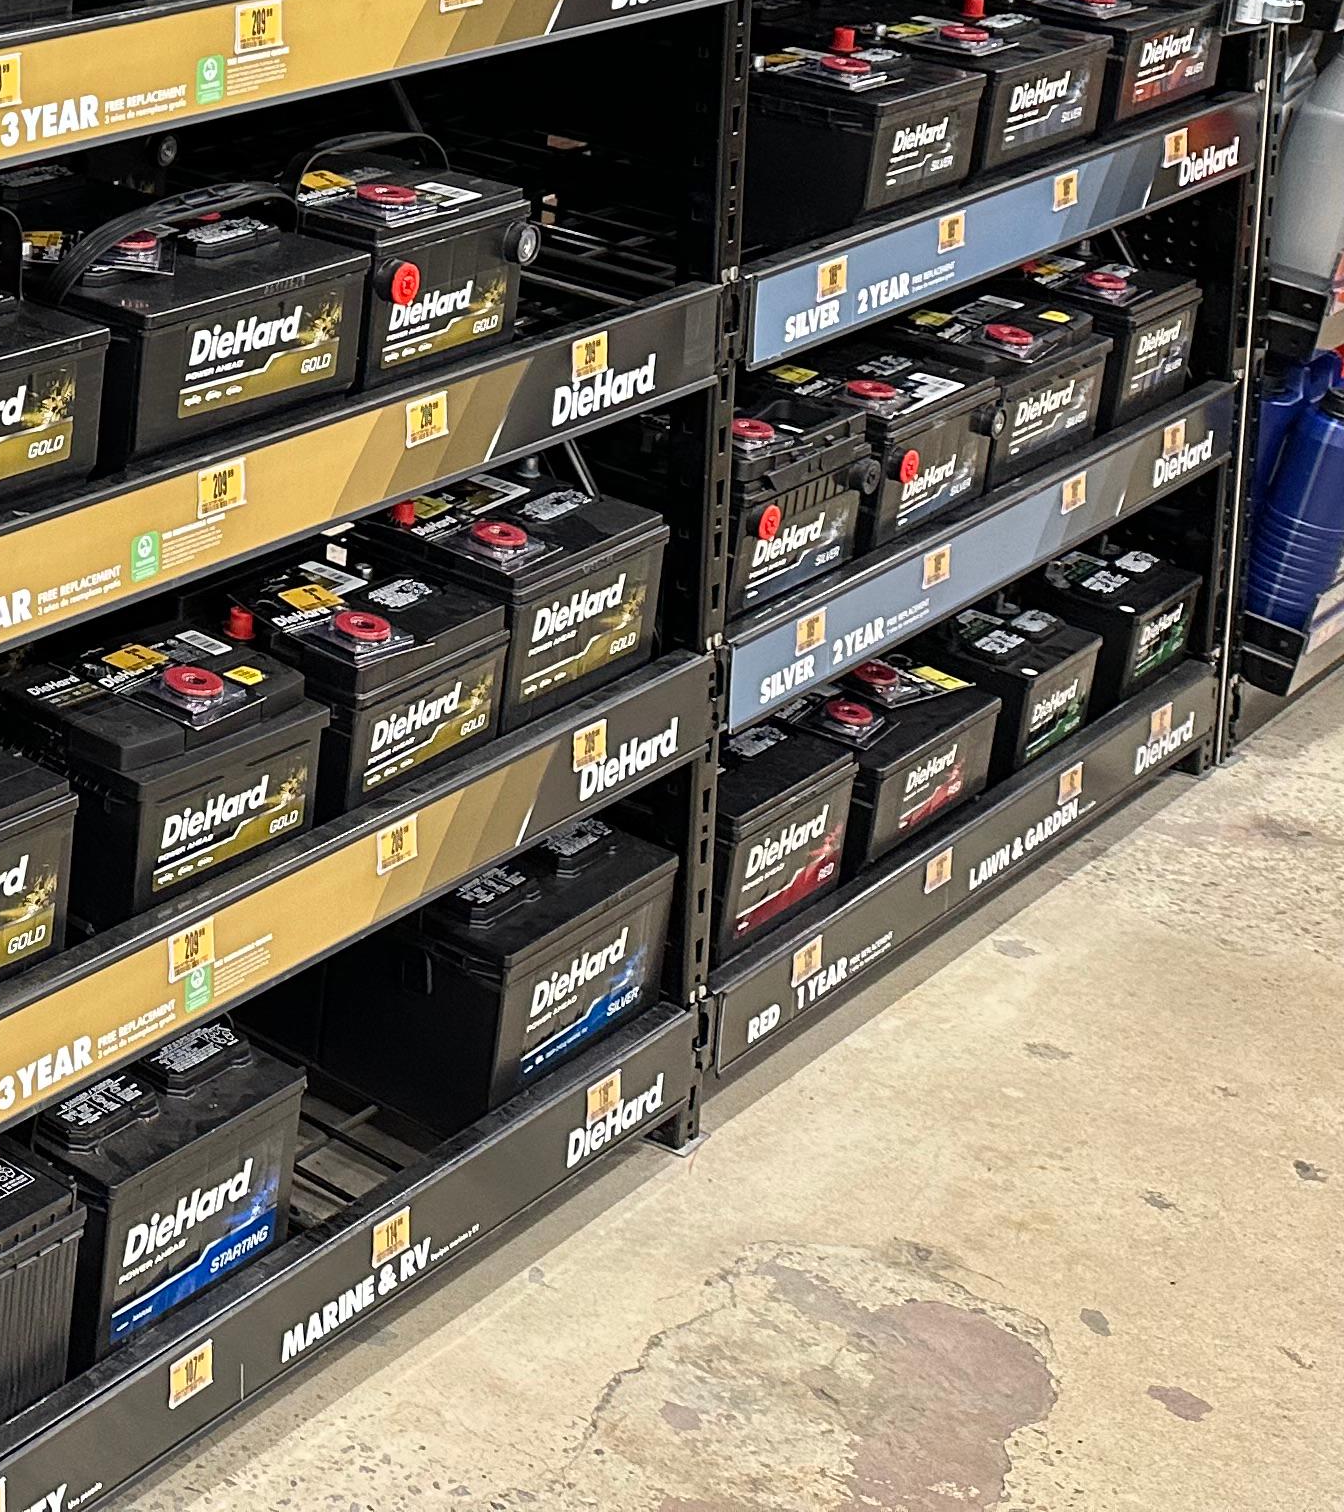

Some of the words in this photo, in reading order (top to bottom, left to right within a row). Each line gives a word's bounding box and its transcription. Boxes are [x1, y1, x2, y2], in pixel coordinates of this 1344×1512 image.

[0, 111, 19, 148] 3
[23, 95, 100, 139] YEAR
[1179, 138, 1240, 187] DieHard
[784, 301, 840, 343] SILVER
[552, 354, 656, 427] DieHard
[27, 435, 64, 459] GOLD
[1153, 432, 1214, 488] DieHard
[760, 660, 815, 705] SILVER
[371, 683, 462, 753] DieHard
[1135, 712, 1195, 774] DieHard
[579, 717, 679, 801] DieHard
[160, 776, 269, 848] DieHard
[745, 805, 829, 880] DieHard
[969, 843, 1011, 891] LAWN
[1012, 834, 1024, 858] &
[1025, 799, 1079, 850] GARDEN
[529, 927, 629, 1018] DieHard
[797, 987, 805, 1010] 1
[806, 958, 848, 1002] YEAR
[748, 1004, 781, 1044] RED
[17, 1036, 93, 1095] YEAR
[566, 1074, 664, 1168] DieHard
[121, 1158, 252, 1268] DieHard
[210, 1225, 269, 1274] STARTING
[281, 1267, 375, 1363] MARINE
[377, 1264, 398, 1296] &
[399, 1236, 432, 1282] RV
